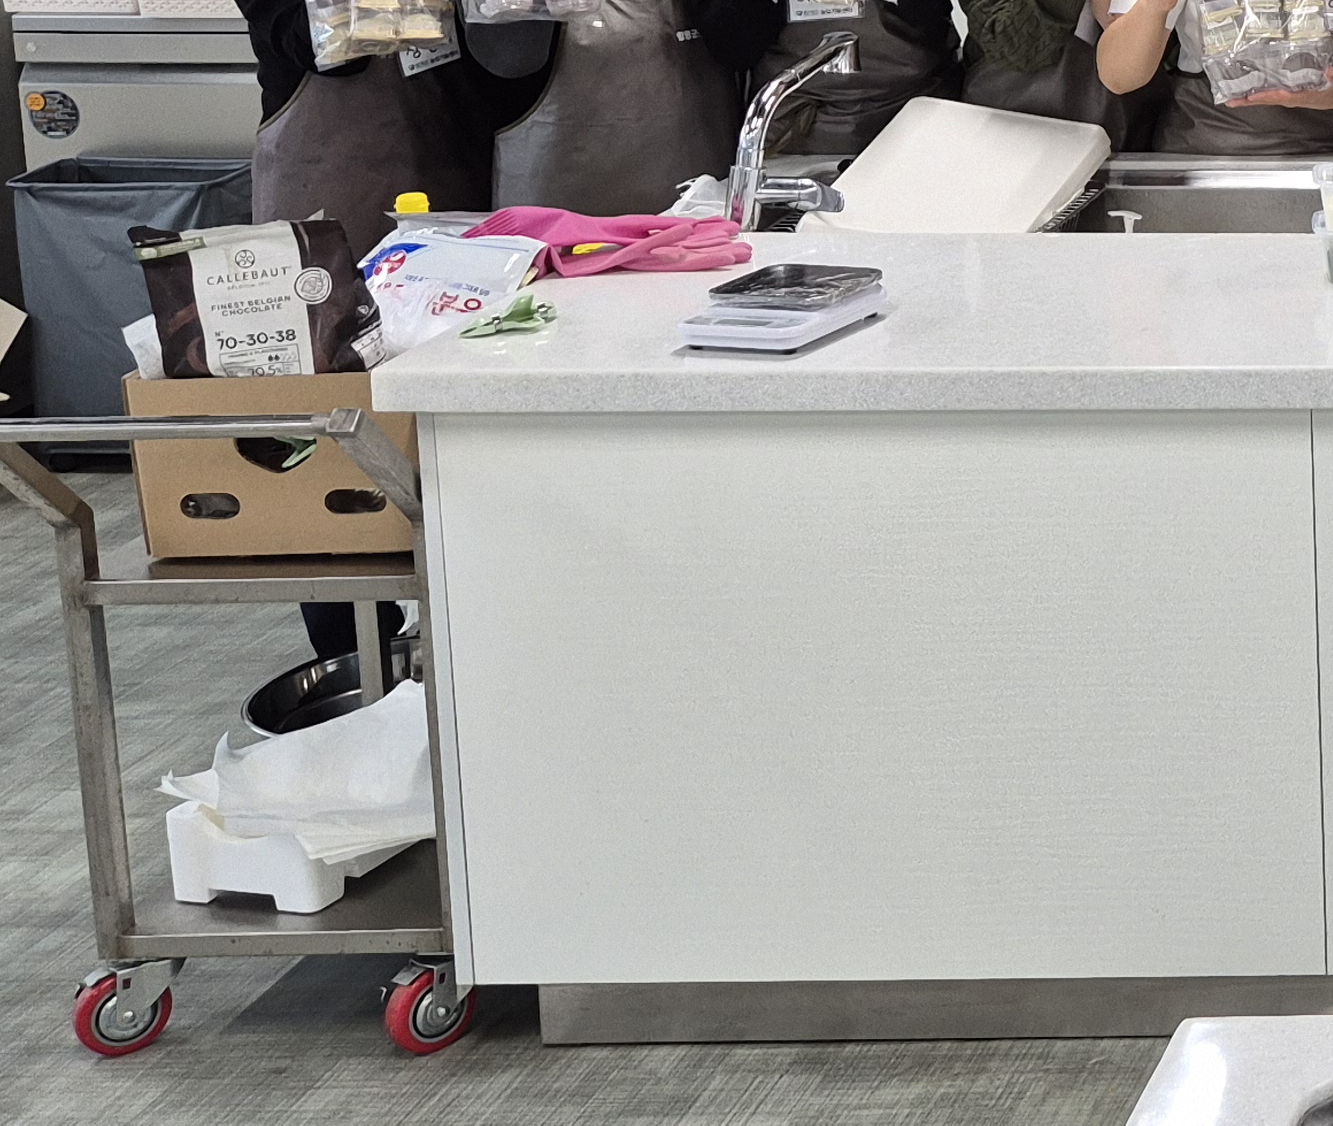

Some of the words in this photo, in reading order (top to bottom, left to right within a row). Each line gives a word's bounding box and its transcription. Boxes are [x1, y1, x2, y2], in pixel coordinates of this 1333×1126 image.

[206, 266, 292, 285] CALLEBAUT
[211, 300, 245, 312] FINEST
[247, 295, 291, 307] BELGIAN
[221, 303, 283, 317] CHOCOLATE
[216, 328, 297, 351] 70-30-38
